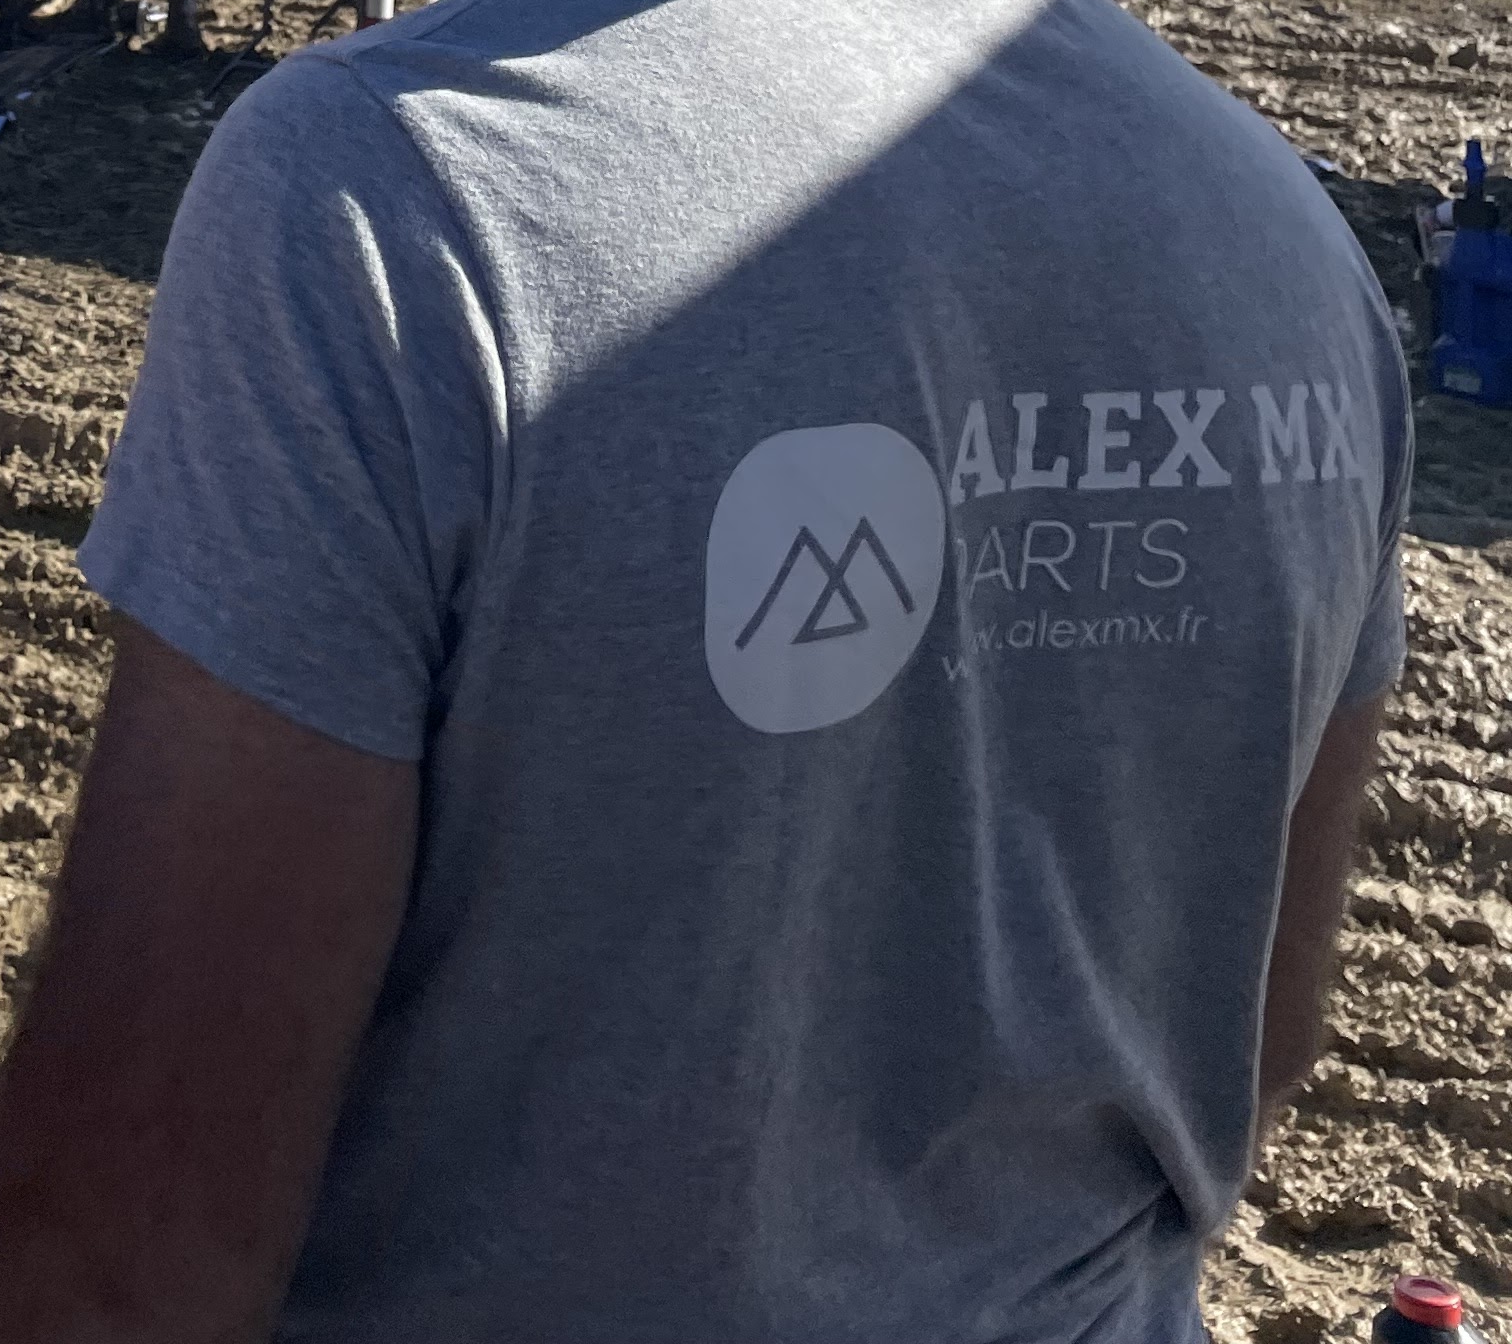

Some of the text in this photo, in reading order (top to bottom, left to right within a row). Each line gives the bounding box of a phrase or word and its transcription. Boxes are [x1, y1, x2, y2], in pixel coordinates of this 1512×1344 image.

[950, 382, 1365, 507] ALEX MX
[955, 518, 1190, 601] ARTS
